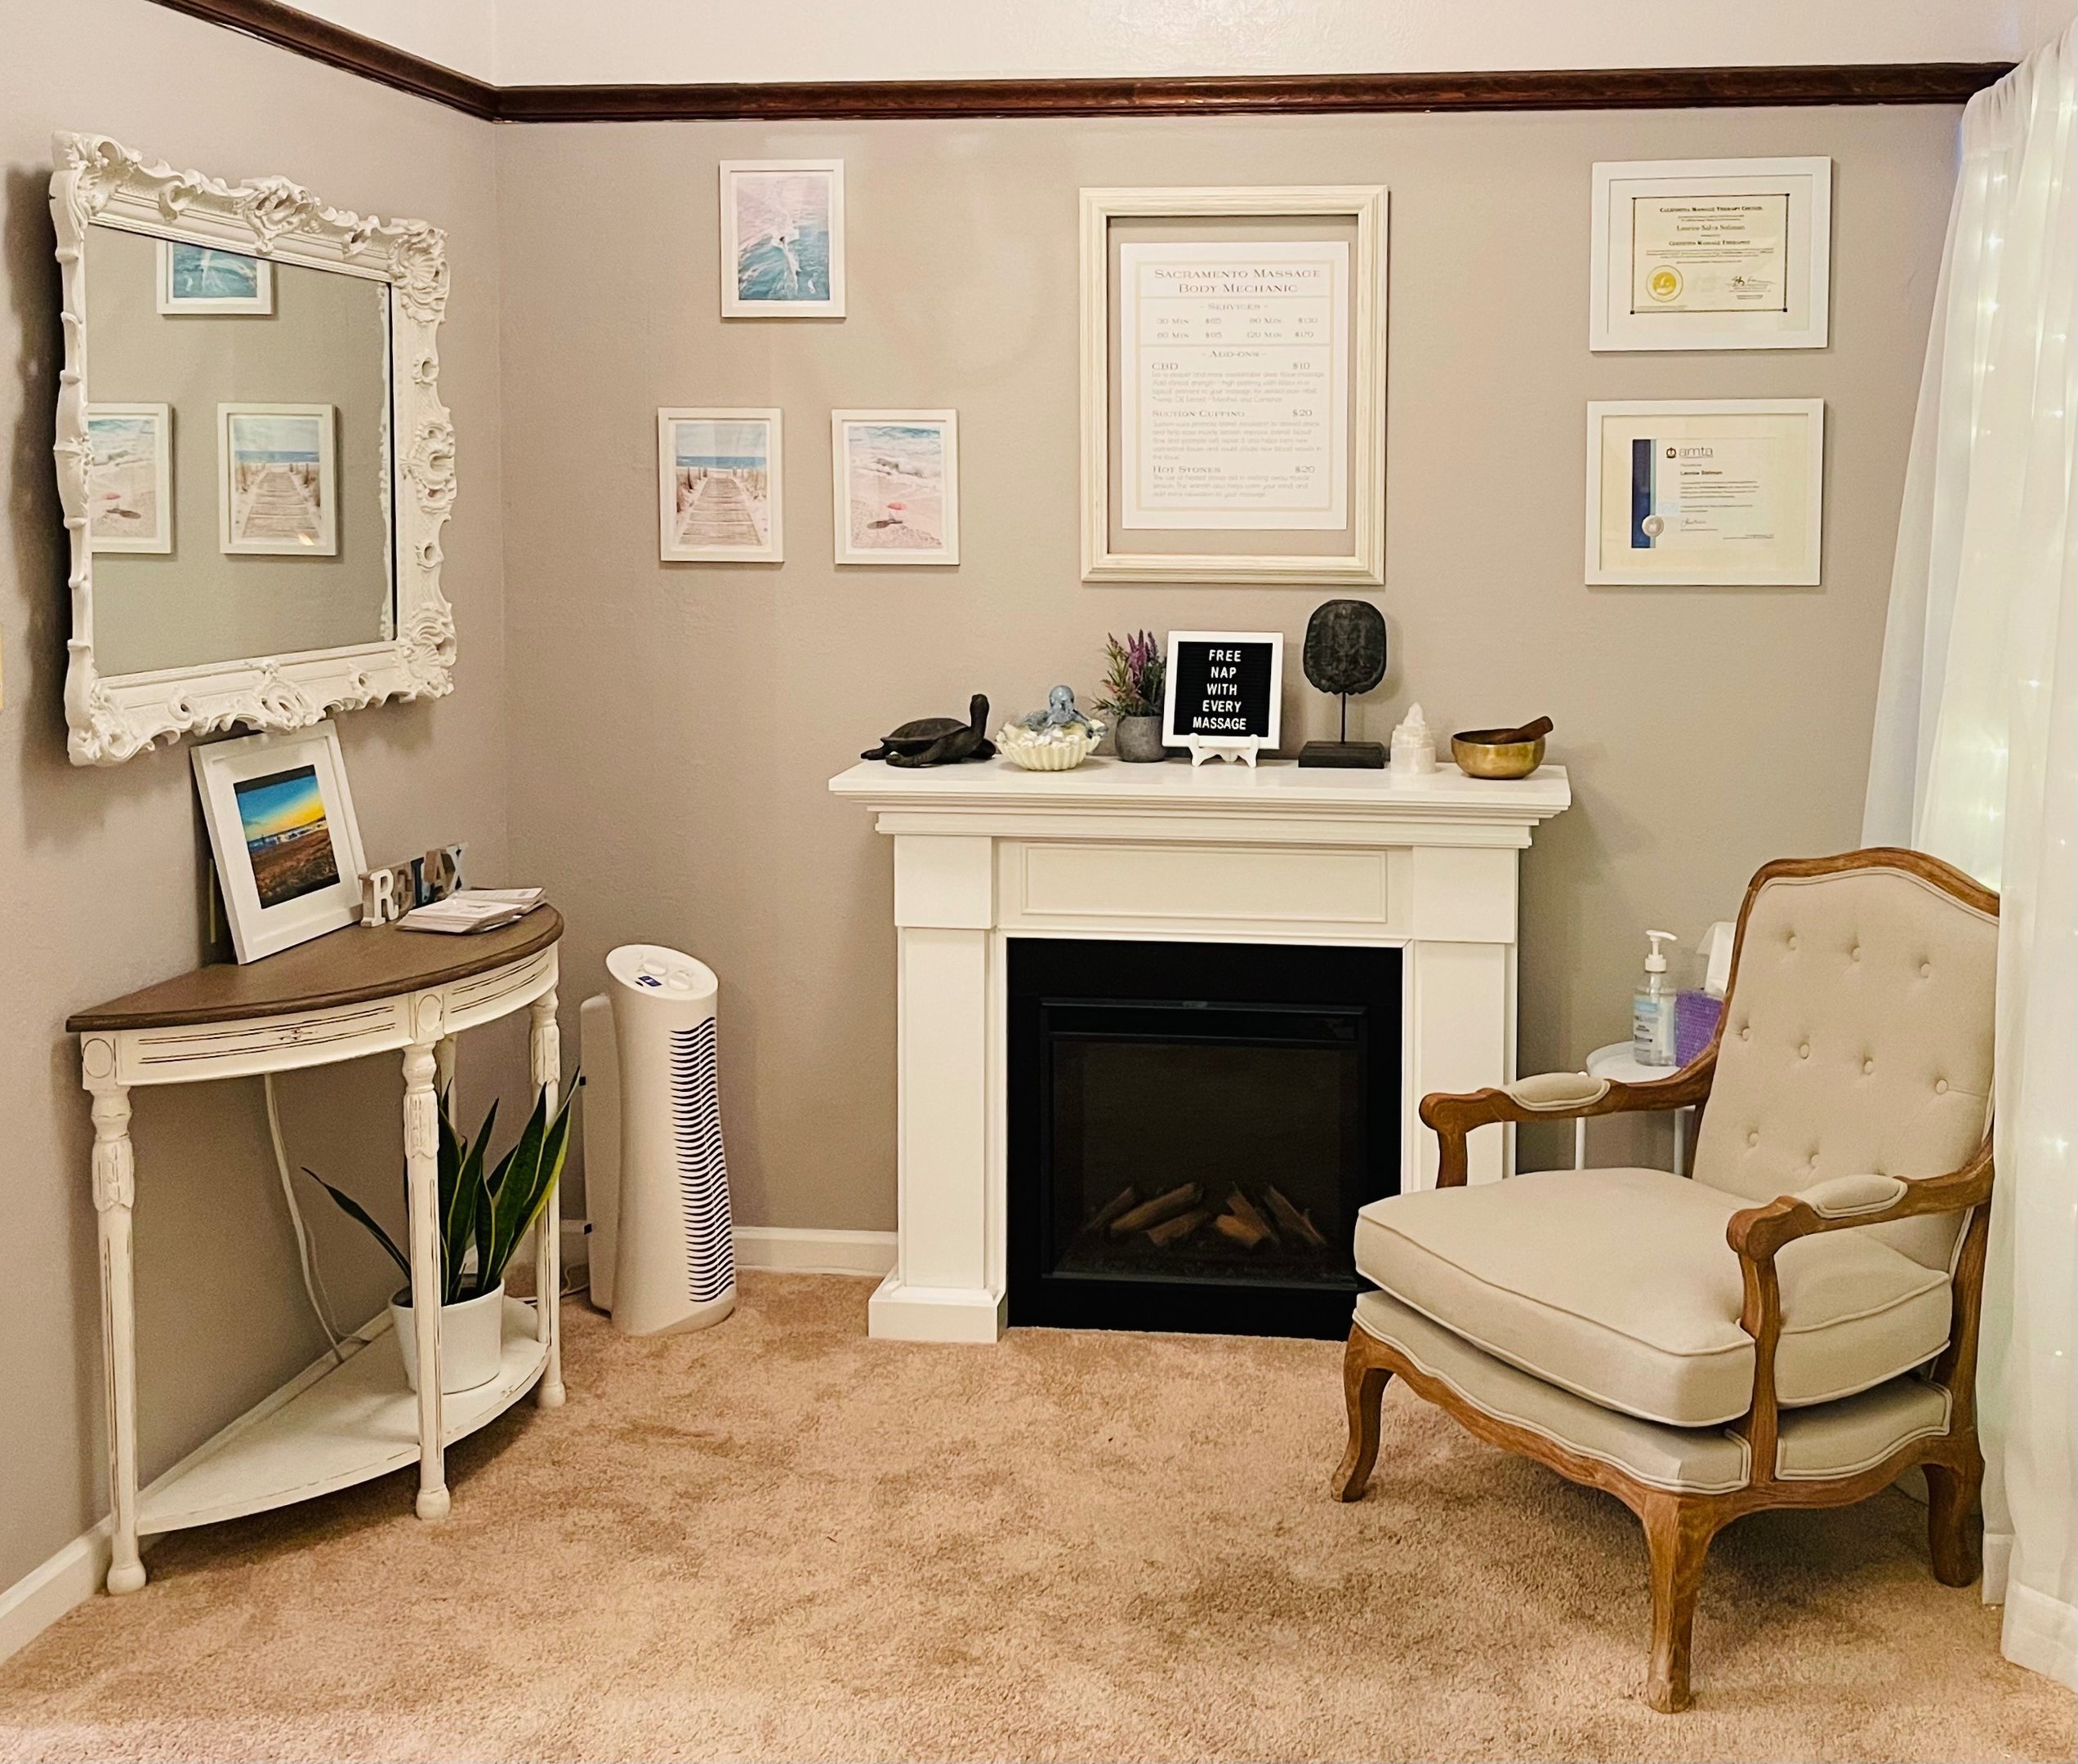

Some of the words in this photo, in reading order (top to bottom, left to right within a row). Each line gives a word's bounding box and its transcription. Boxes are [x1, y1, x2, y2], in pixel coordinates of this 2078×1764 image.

[1152, 362, 1179, 371] CBD
[1292, 362, 1310, 370] $10
[1292, 409, 1313, 417] $20
[1679, 447, 1714, 457] amta
[1209, 649, 1242, 662] FREE
[1211, 666, 1237, 679] NAP
[1206, 683, 1237, 696] WITH
[1202, 700, 1242, 713] EVERY
[1193, 716, 1247, 730] MASSAGE
